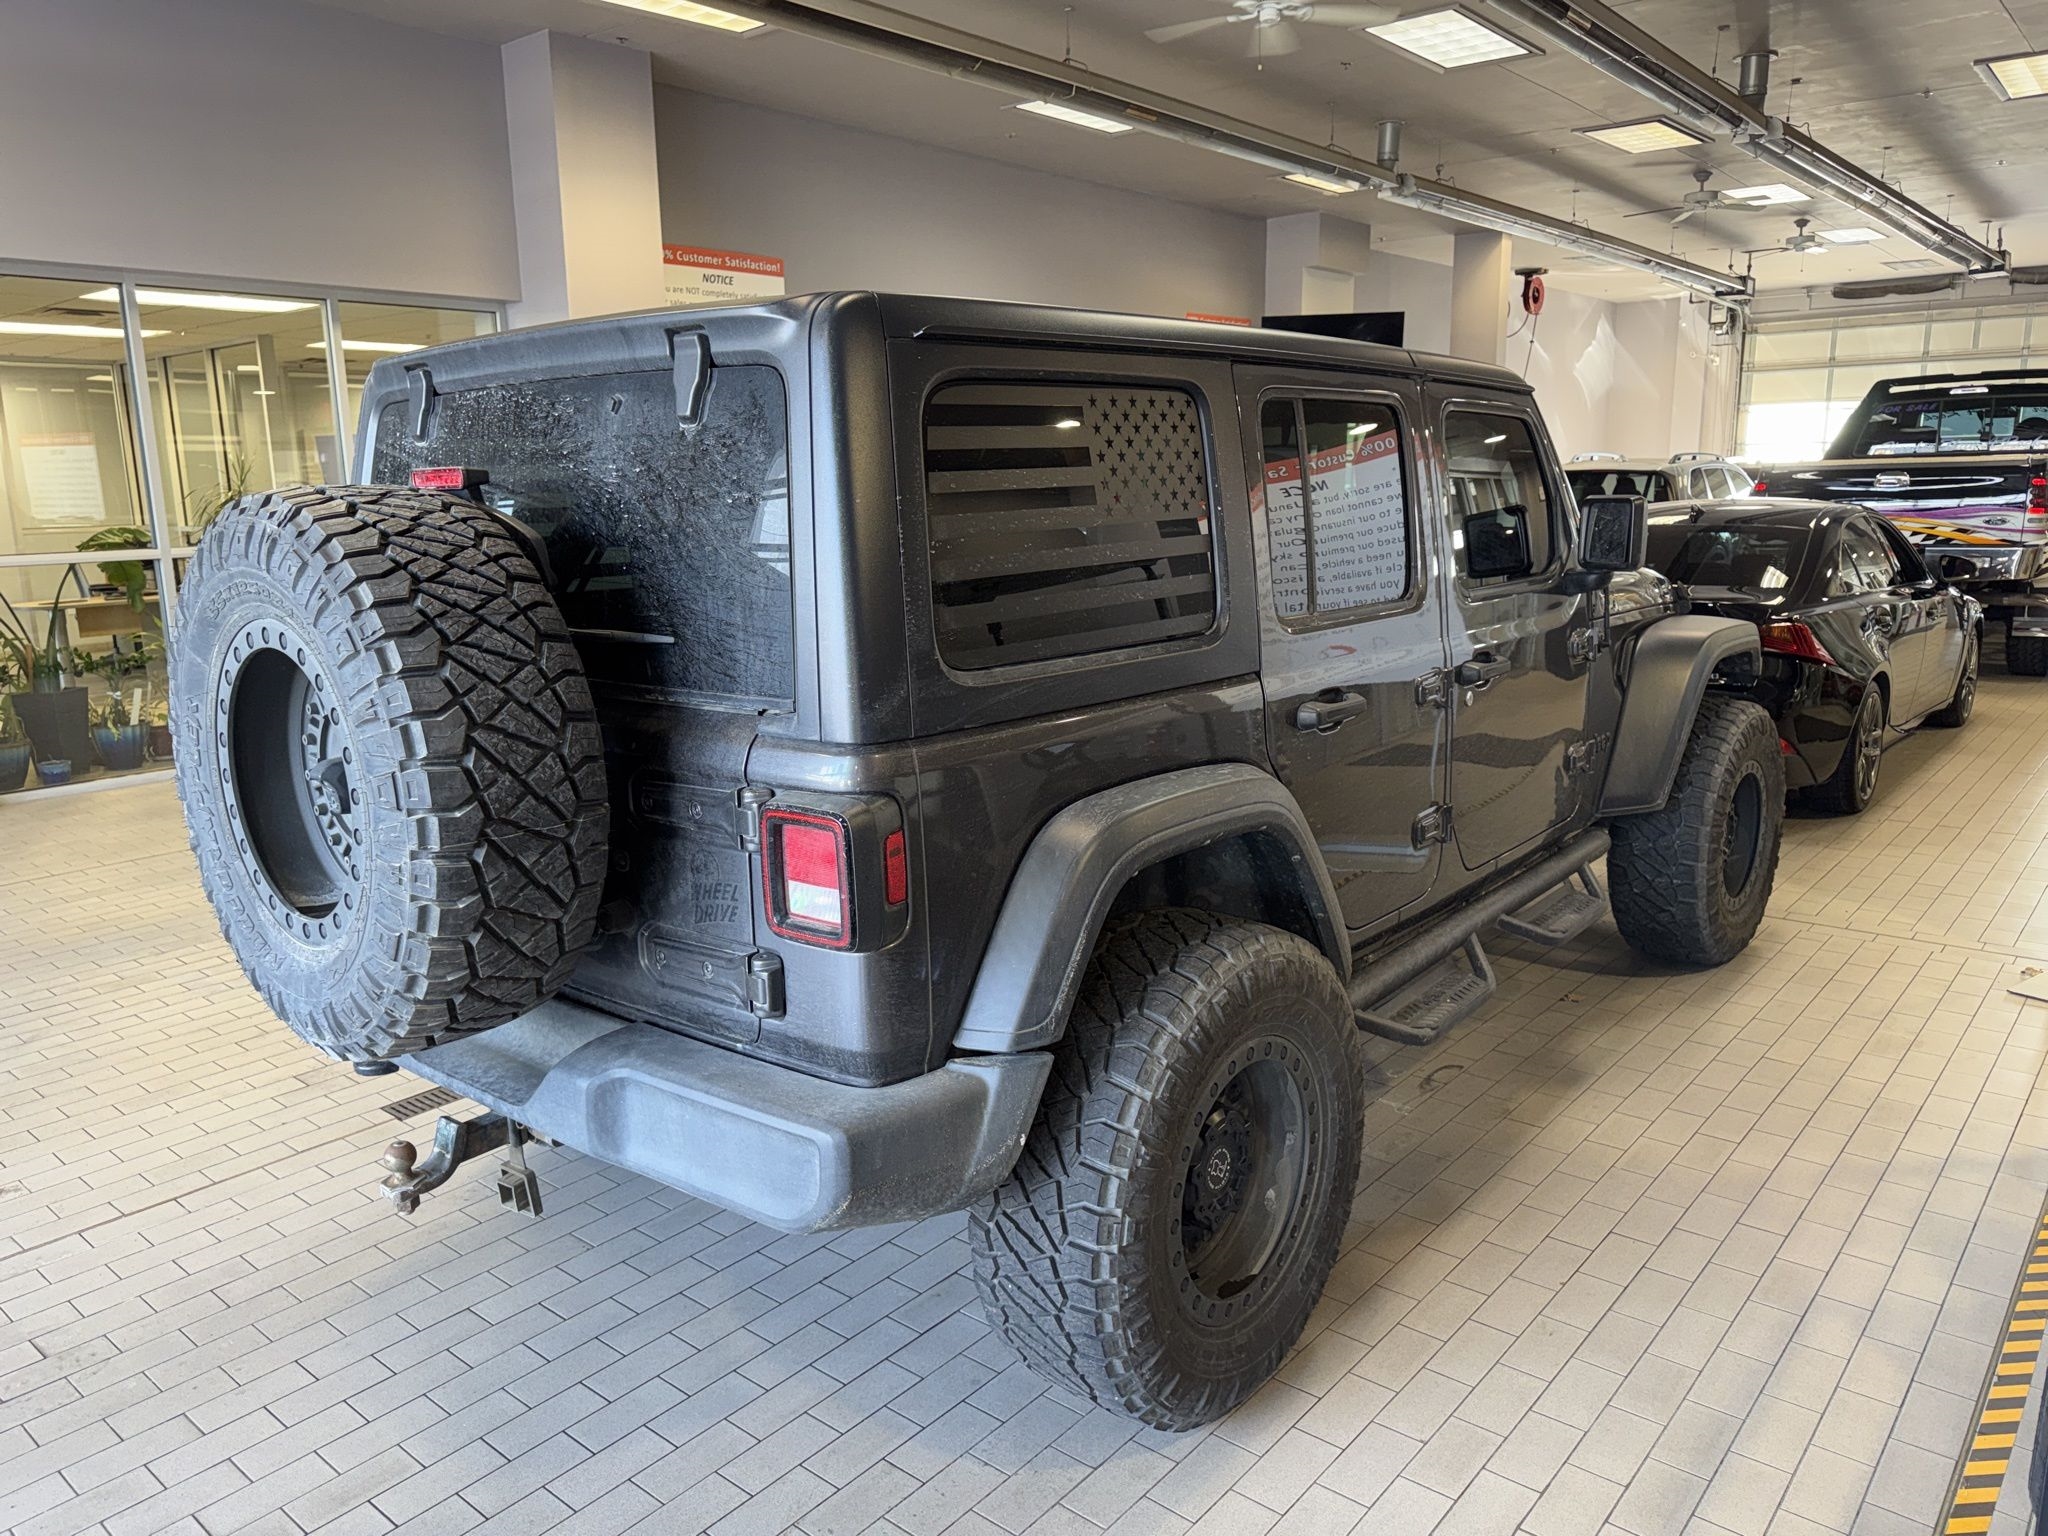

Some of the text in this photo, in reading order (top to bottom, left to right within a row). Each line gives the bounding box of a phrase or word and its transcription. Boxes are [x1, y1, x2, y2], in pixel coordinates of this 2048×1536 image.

[676, 251, 722, 266] Customer
[725, 257, 781, 272] Satisfaction!
[702, 273, 734, 285] NOTICE
[686, 287, 700, 295] NOT
[702, 289, 738, 299] completely
[691, 882, 739, 902] WHEEL
[694, 904, 739, 924] DRIVE
